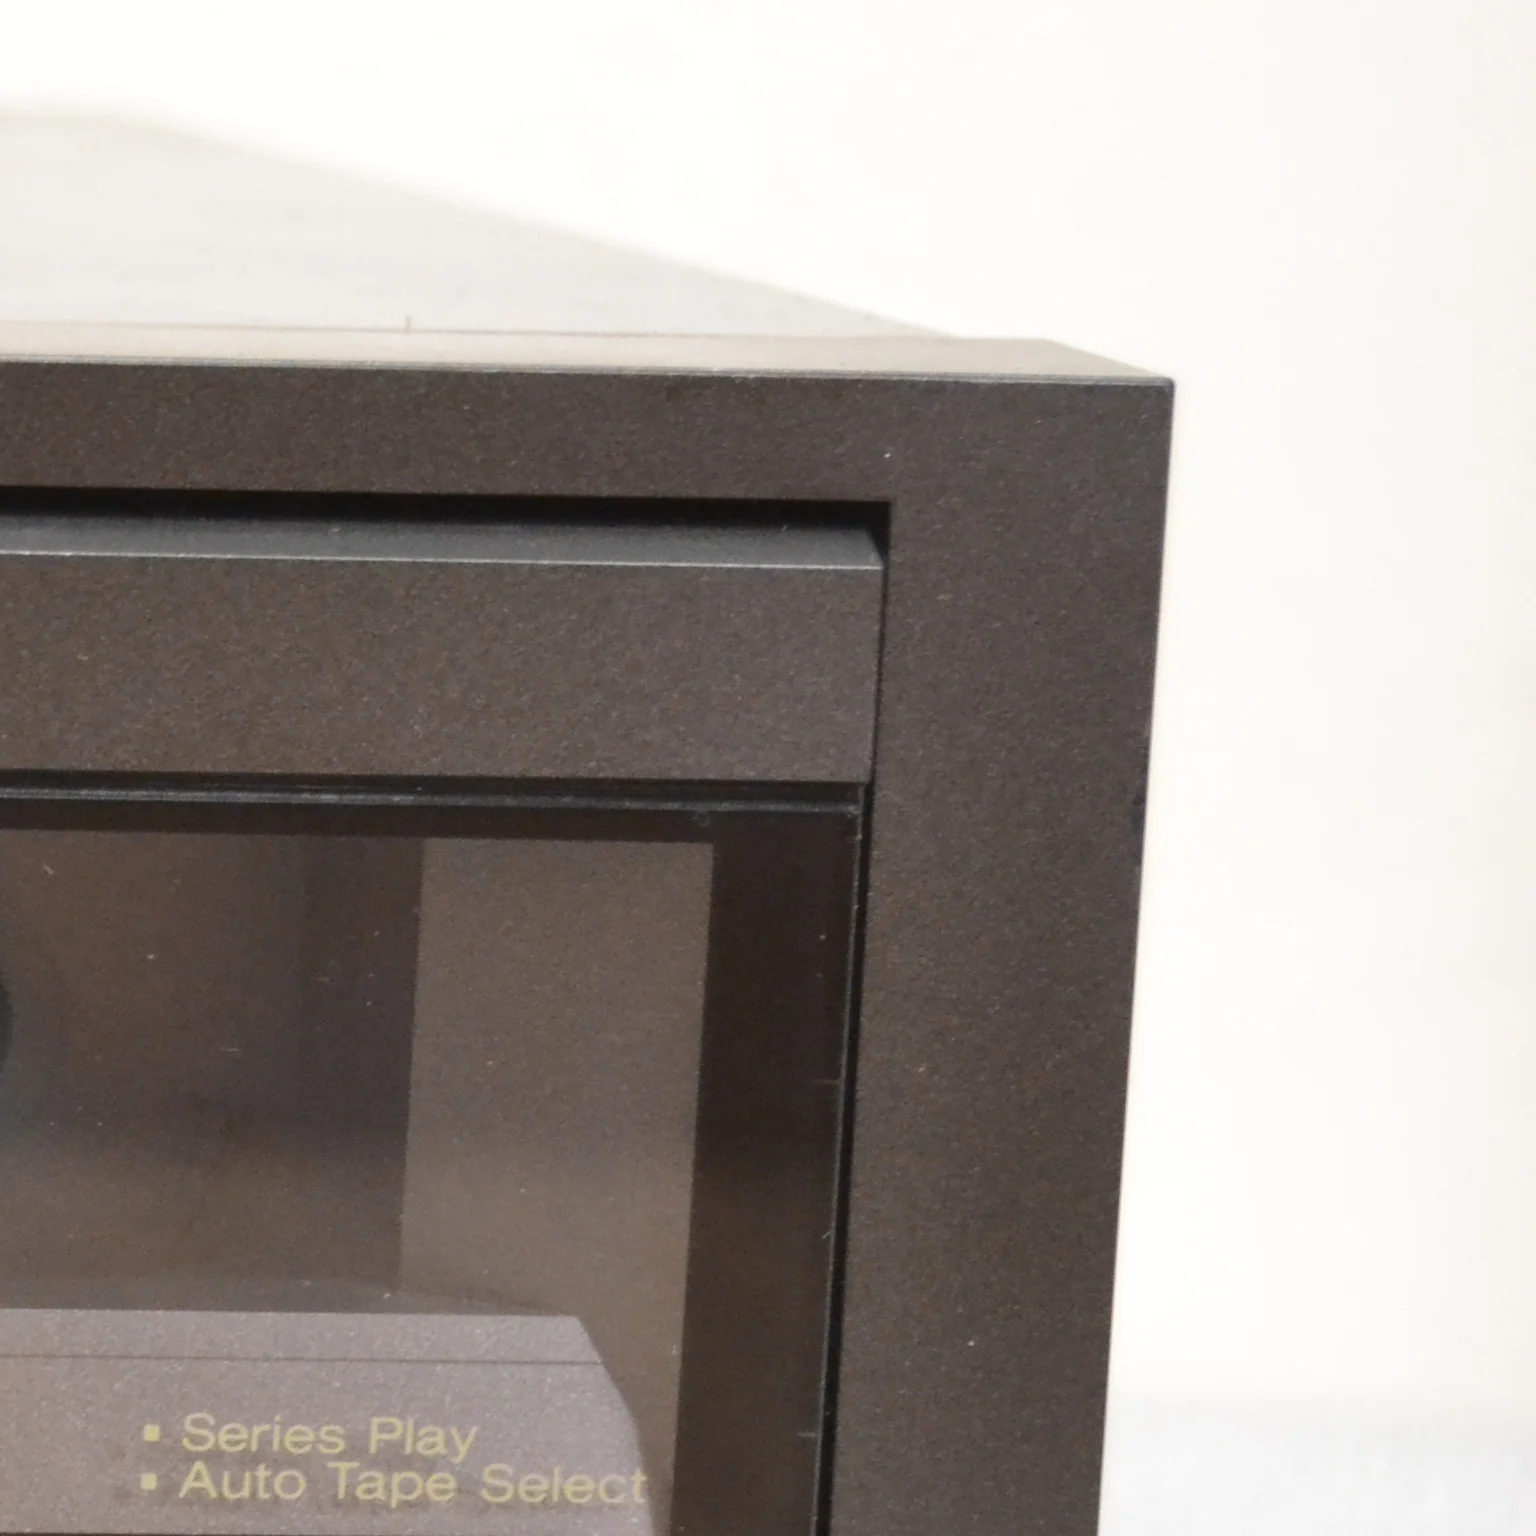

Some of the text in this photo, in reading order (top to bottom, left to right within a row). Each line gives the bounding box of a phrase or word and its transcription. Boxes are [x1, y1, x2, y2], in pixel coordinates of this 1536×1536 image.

[181, 1411, 480, 1463] Series Play
[178, 1460, 648, 1508] Auto Tape Select
